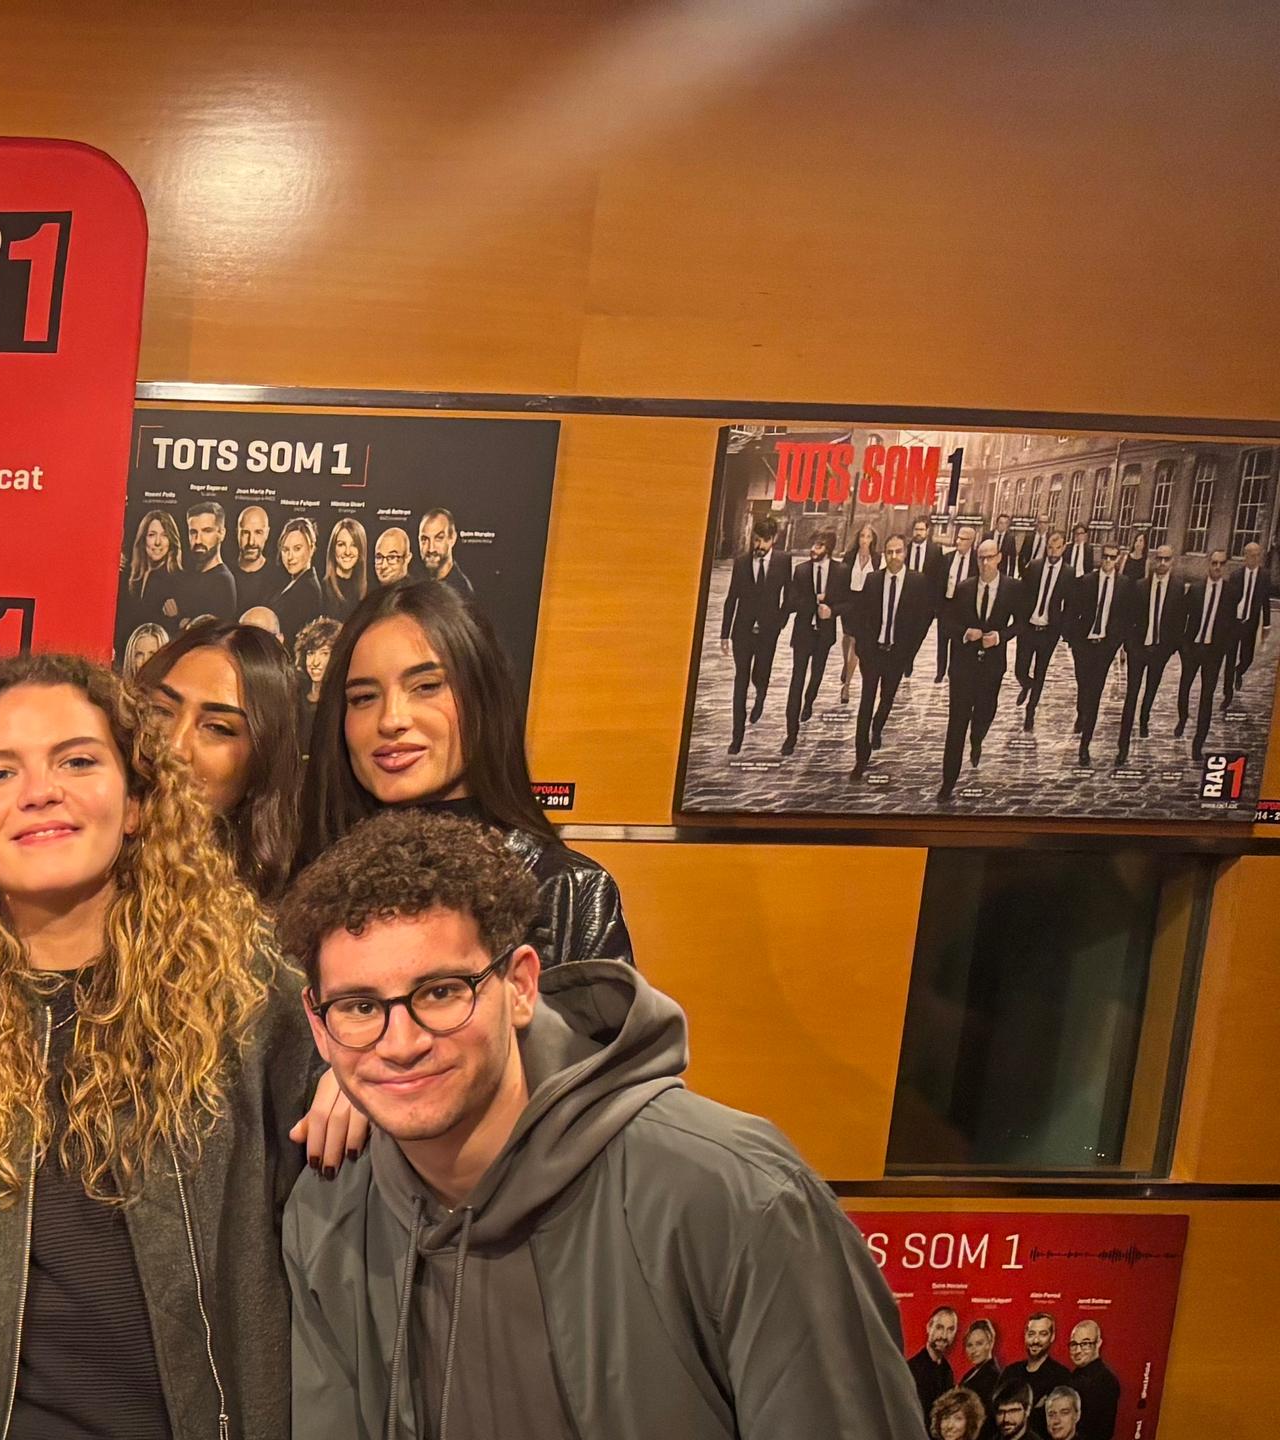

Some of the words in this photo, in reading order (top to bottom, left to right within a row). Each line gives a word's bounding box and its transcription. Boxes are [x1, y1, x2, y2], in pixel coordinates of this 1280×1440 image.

[8, 221, 62, 343] 1
[152, 437, 239, 473] TOTS
[245, 440, 323, 476] SOM
[330, 443, 352, 476] 1
[773, 441, 855, 504] TOTS
[858, 443, 942, 509] SOM
[947, 446, 965, 507] 1
[1202, 756, 1227, 798] RAC
[1227, 756, 1247, 799] 1
[901, 1232, 988, 1270] SOM
[1001, 1233, 1025, 1271] 1
